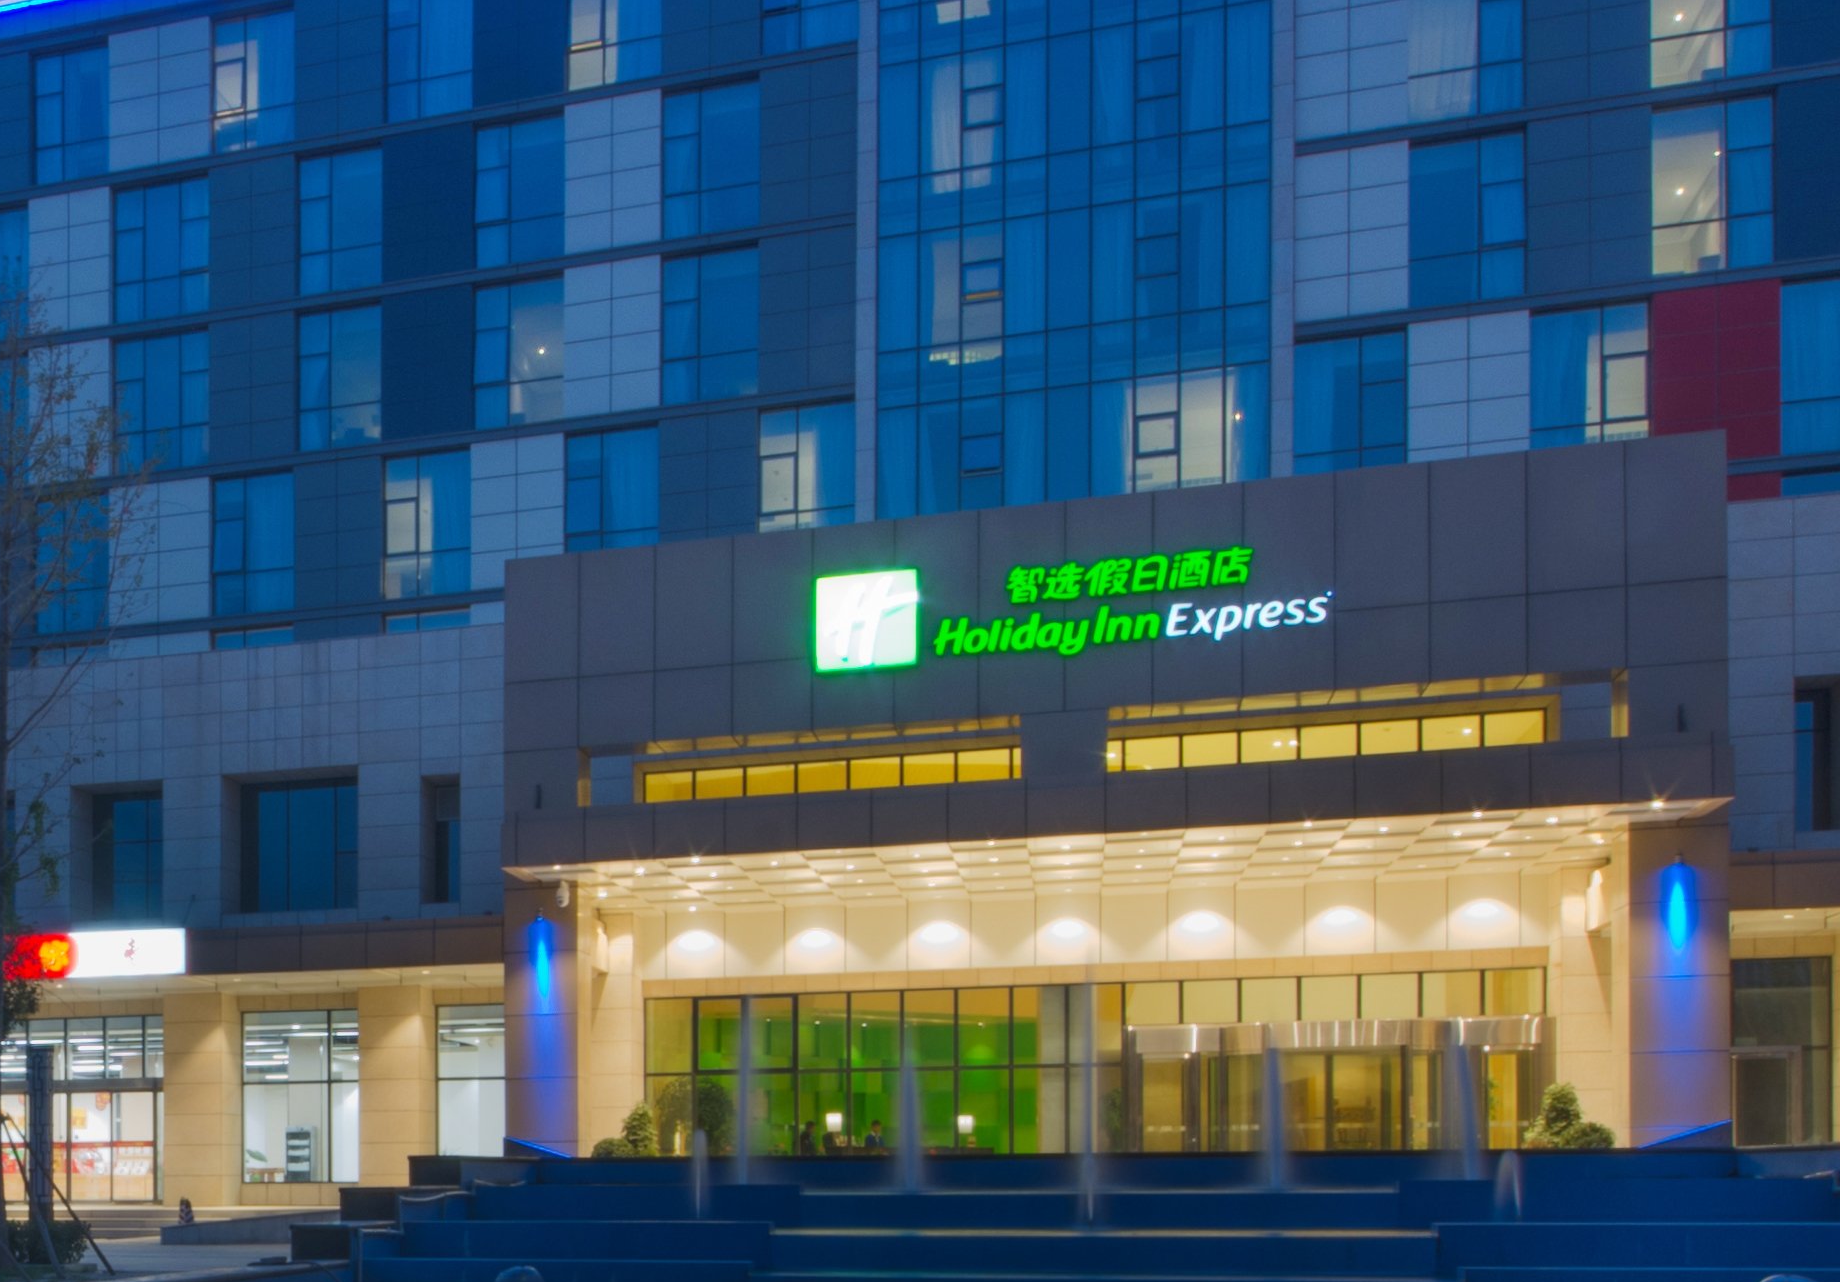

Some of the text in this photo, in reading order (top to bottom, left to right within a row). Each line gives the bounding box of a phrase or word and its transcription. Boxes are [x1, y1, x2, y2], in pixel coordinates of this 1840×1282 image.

[1006, 547, 1253, 603] 智选假日酒店
[933, 595, 1329, 656] Holiday Inn Express
